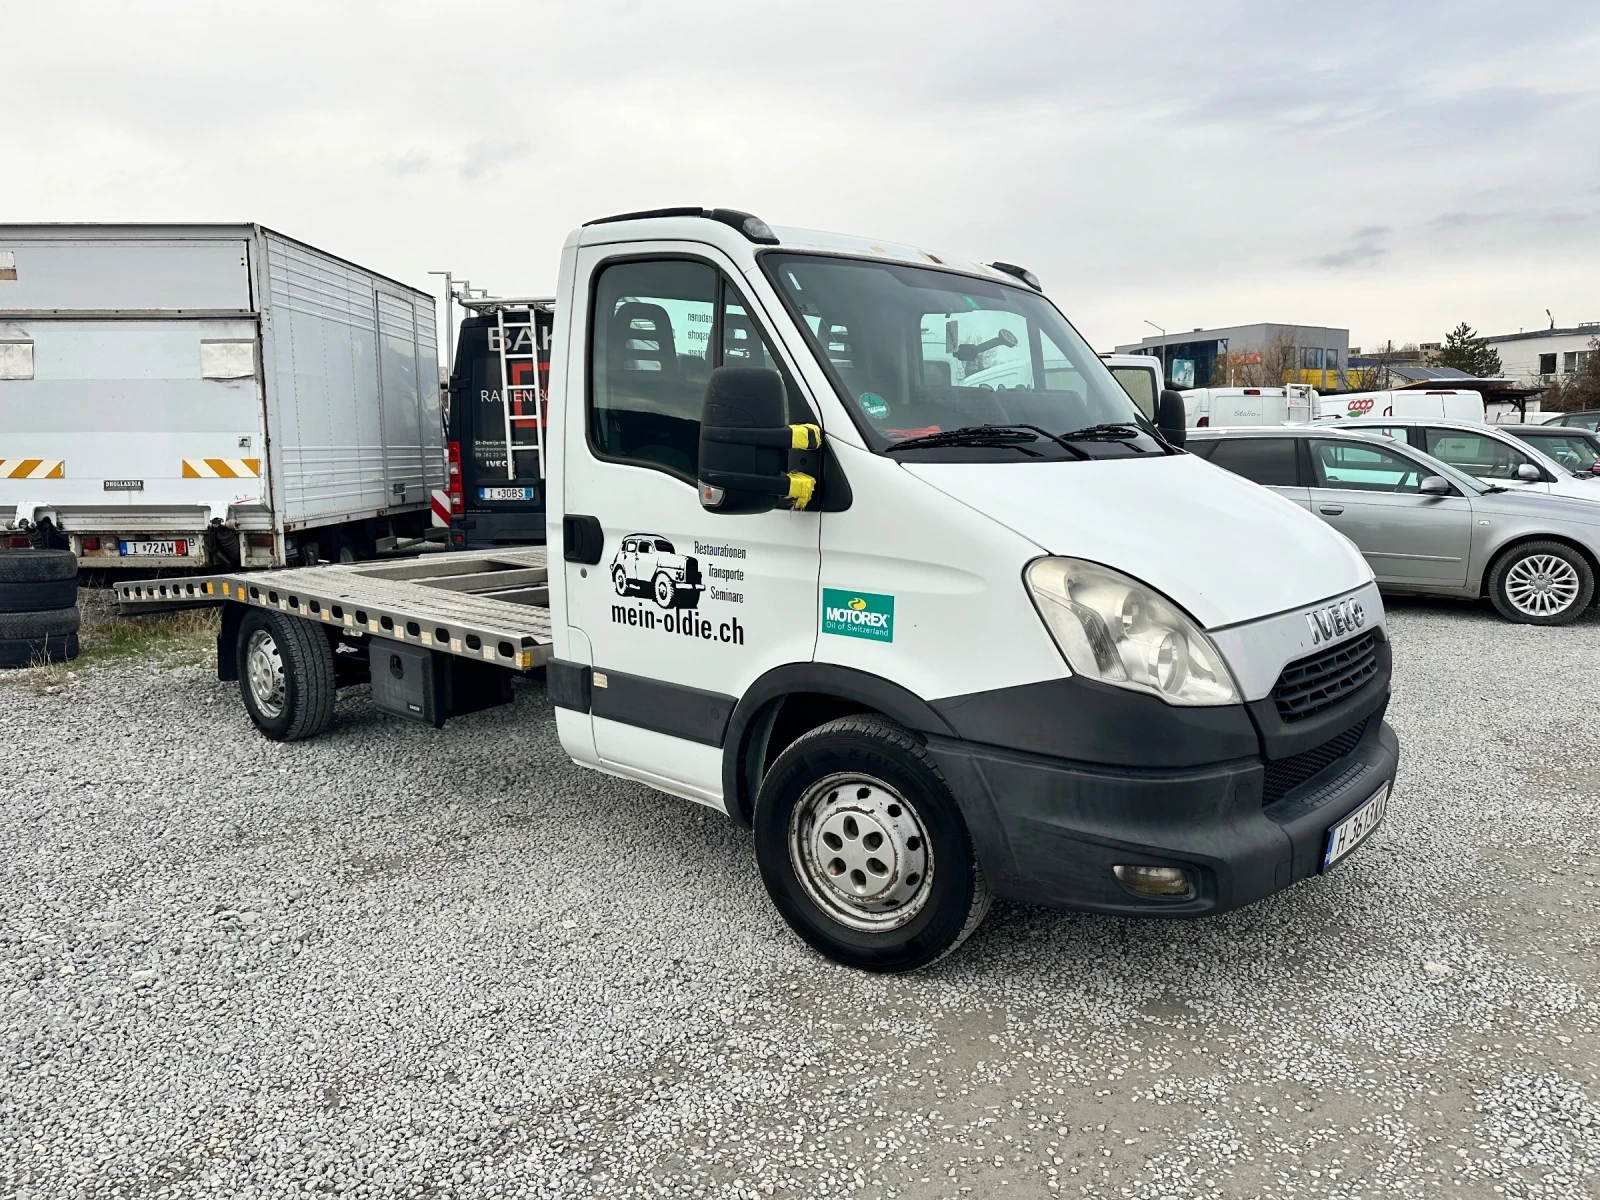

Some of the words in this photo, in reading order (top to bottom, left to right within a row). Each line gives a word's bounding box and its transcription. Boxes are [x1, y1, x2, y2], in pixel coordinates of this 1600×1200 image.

[486, 460, 508, 468] IVEC
[147, 543, 174, 554] 72AW
[188, 538, 196, 547] B
[694, 540, 746, 560] Restaurationen
[708, 563, 744, 583] Transporte
[710, 586, 744, 604] Seminare
[611, 602, 744, 646] mein-oldie.ch
[826, 606, 888, 629] MOTOREX
[1305, 598, 1366, 645] IVECO
[826, 620, 836, 629] Oil
[847, 623, 889, 637] Switzerland
